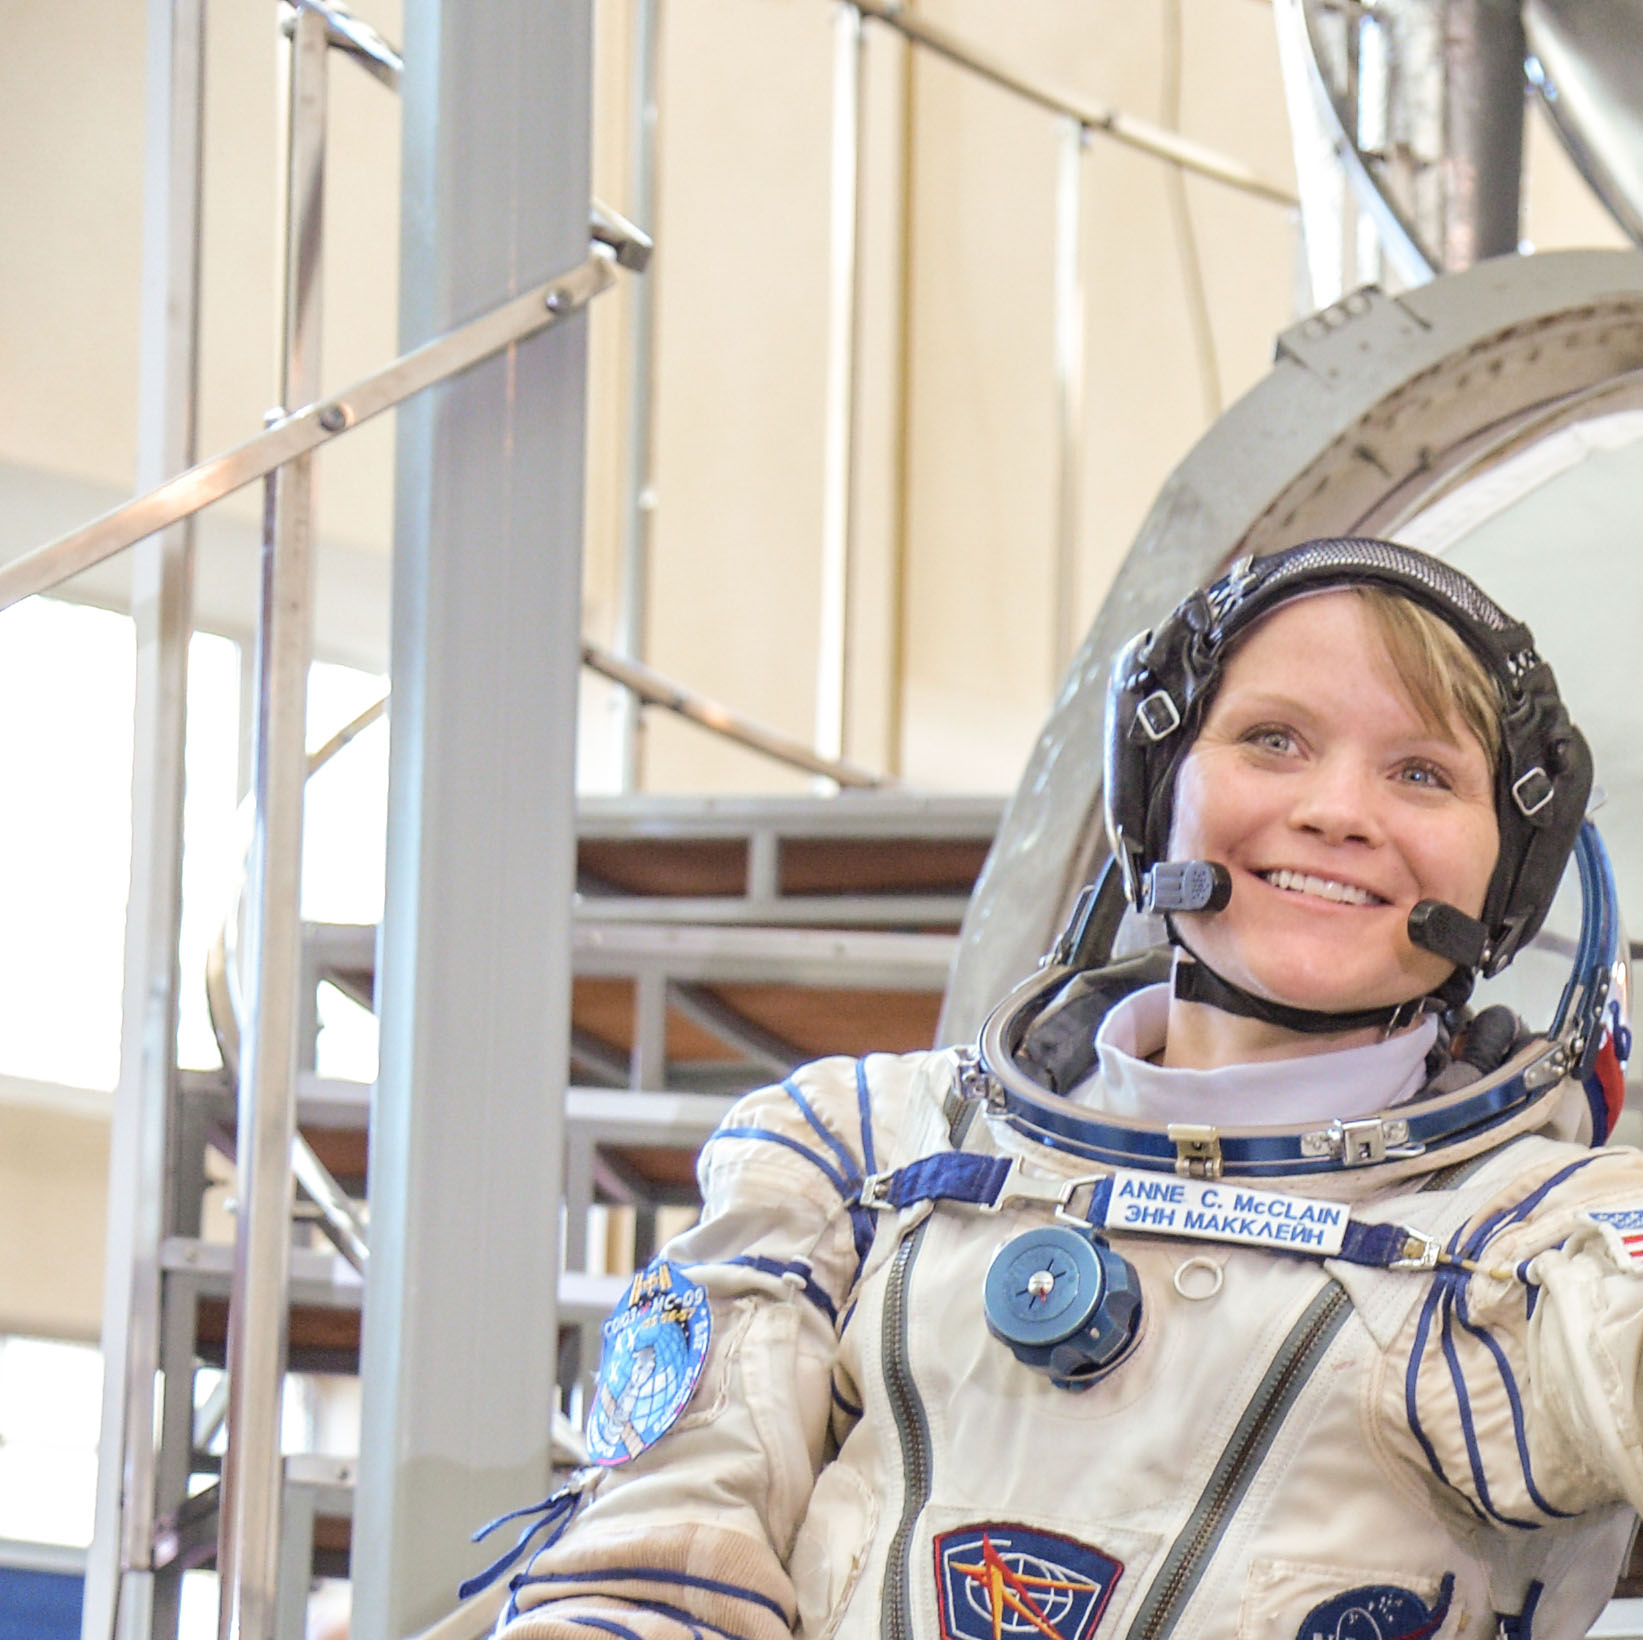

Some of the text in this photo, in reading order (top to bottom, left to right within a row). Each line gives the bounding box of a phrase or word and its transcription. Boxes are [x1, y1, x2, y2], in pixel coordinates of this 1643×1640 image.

[1118, 1179, 1341, 1226] ANNE C. McCLAIN
[1124, 1204, 1325, 1246] ЭНН МАККЛЕЙН
